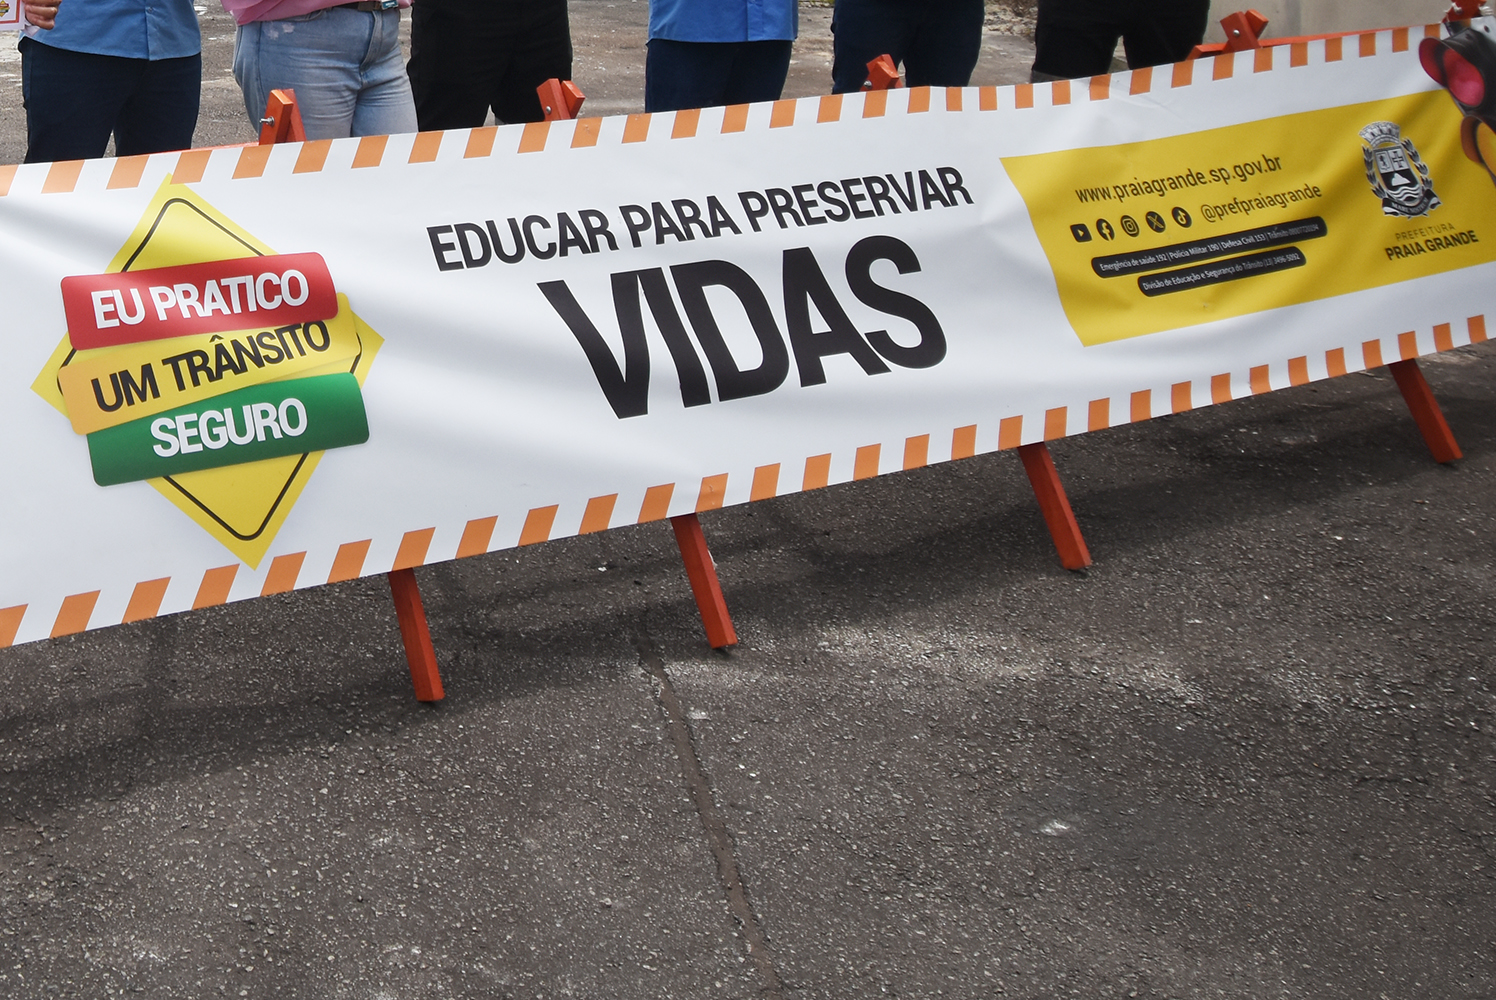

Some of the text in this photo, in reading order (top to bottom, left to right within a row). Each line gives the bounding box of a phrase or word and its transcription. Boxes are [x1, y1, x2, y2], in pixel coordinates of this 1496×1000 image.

[1075, 154, 1283, 204] www.praiagrande.sp.gov.br
[1201, 183, 1322, 223] @prefpraiagrande
[426, 166, 974, 272] EDUCAR PARA PRESERVAR
[1395, 222, 1456, 241] PREFEITURA
[1099, 260, 1132, 272] Emergência
[1132, 258, 1139, 267] de
[1156, 253, 1166, 262] 192
[1169, 249, 1190, 260] Polícia
[1189, 246, 1208, 256] Militar
[1221, 238, 1243, 249] Defesa
[1385, 230, 1479, 261] PRAIA GRANDE
[91, 269, 310, 329] EU PRATICO
[1142, 280, 1165, 291] Divisão
[1164, 278, 1172, 287] de
[1172, 273, 1201, 285] Educação
[1205, 266, 1235, 279] Segurança
[536, 235, 948, 420] VIDAS
[91, 320, 331, 413] UM TRÂNSITO
[150, 397, 308, 458] SEGURO
